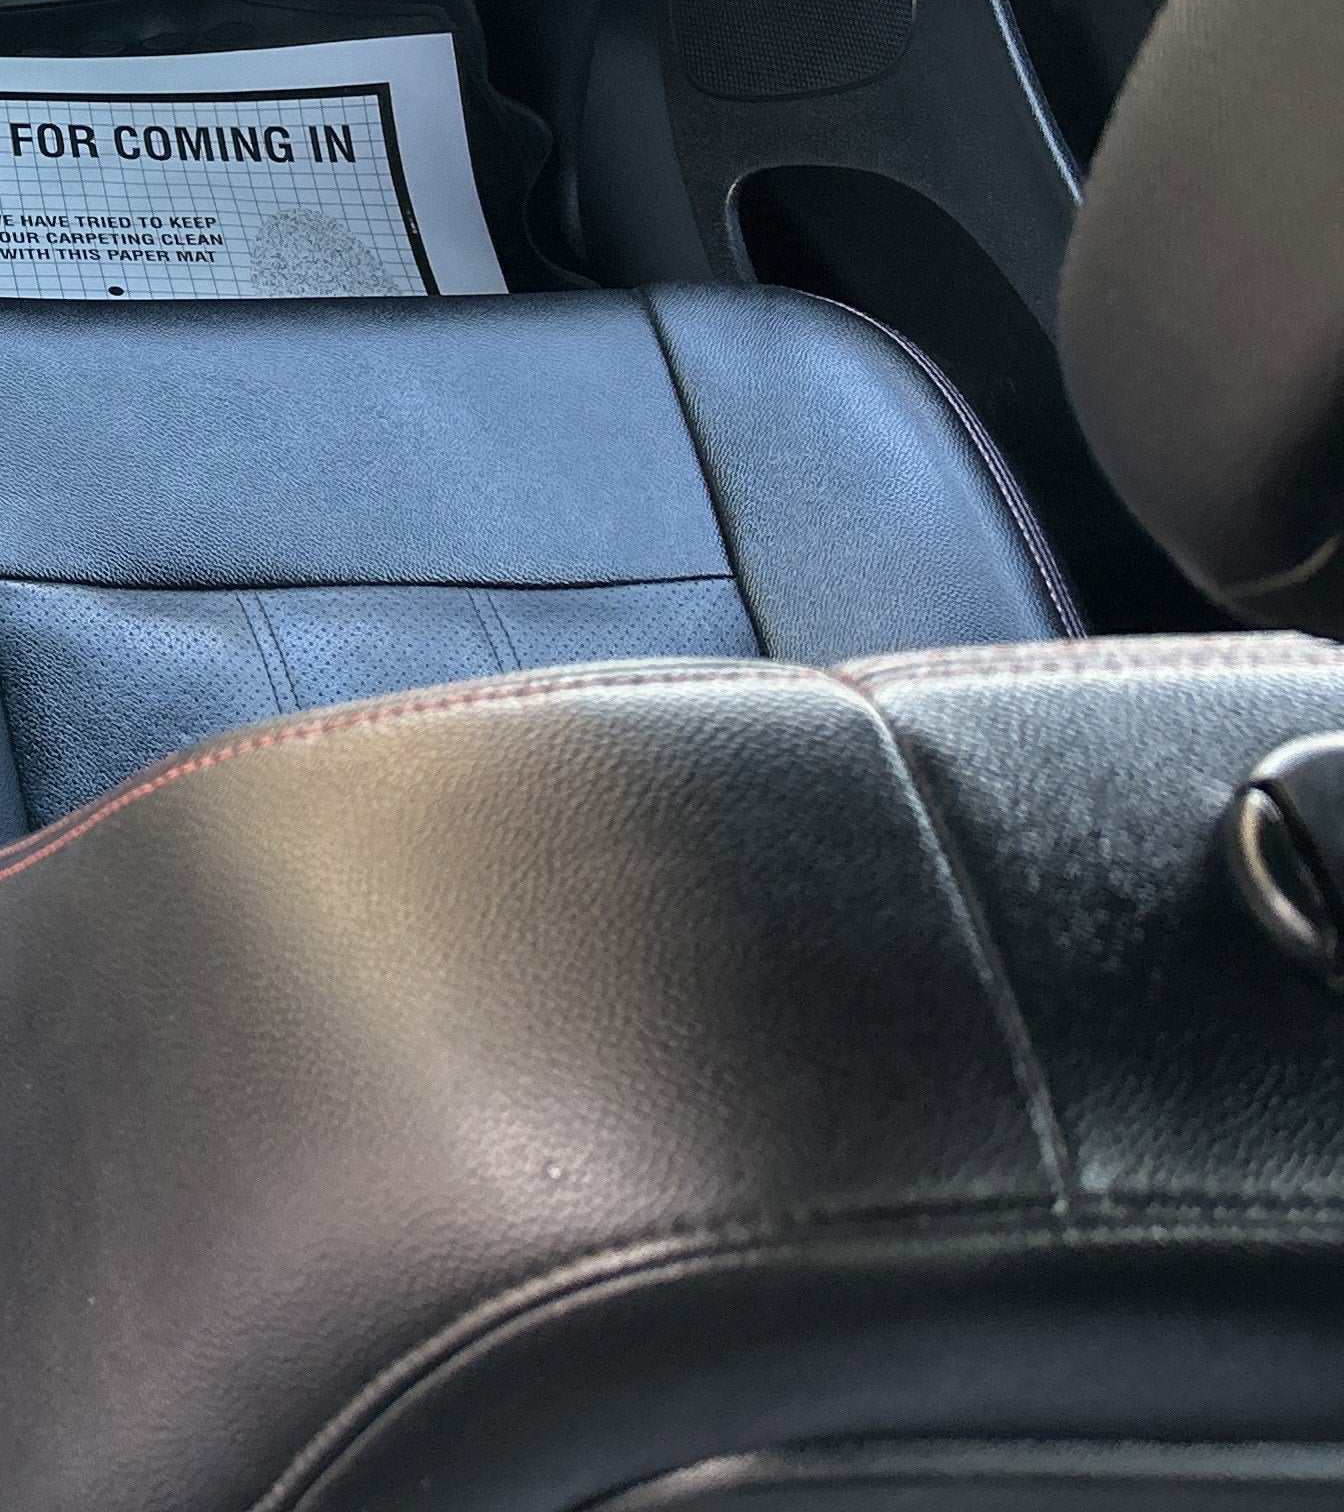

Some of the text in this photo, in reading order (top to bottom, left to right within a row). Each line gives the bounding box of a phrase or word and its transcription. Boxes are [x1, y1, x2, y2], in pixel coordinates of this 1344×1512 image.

[13, 124, 100, 160] FOR
[115, 125, 294, 163] COMING
[309, 125, 357, 163] IN
[21, 215, 69, 228] HAVE
[75, 216, 131, 228] TRIED
[138, 216, 164, 229] TO
[170, 217, 217, 229] KEEP
[47, 232, 154, 245] CARPETING
[161, 234, 223, 246] CLEAN
[0, 248, 216, 262] WITH THIS PAPER MAT
